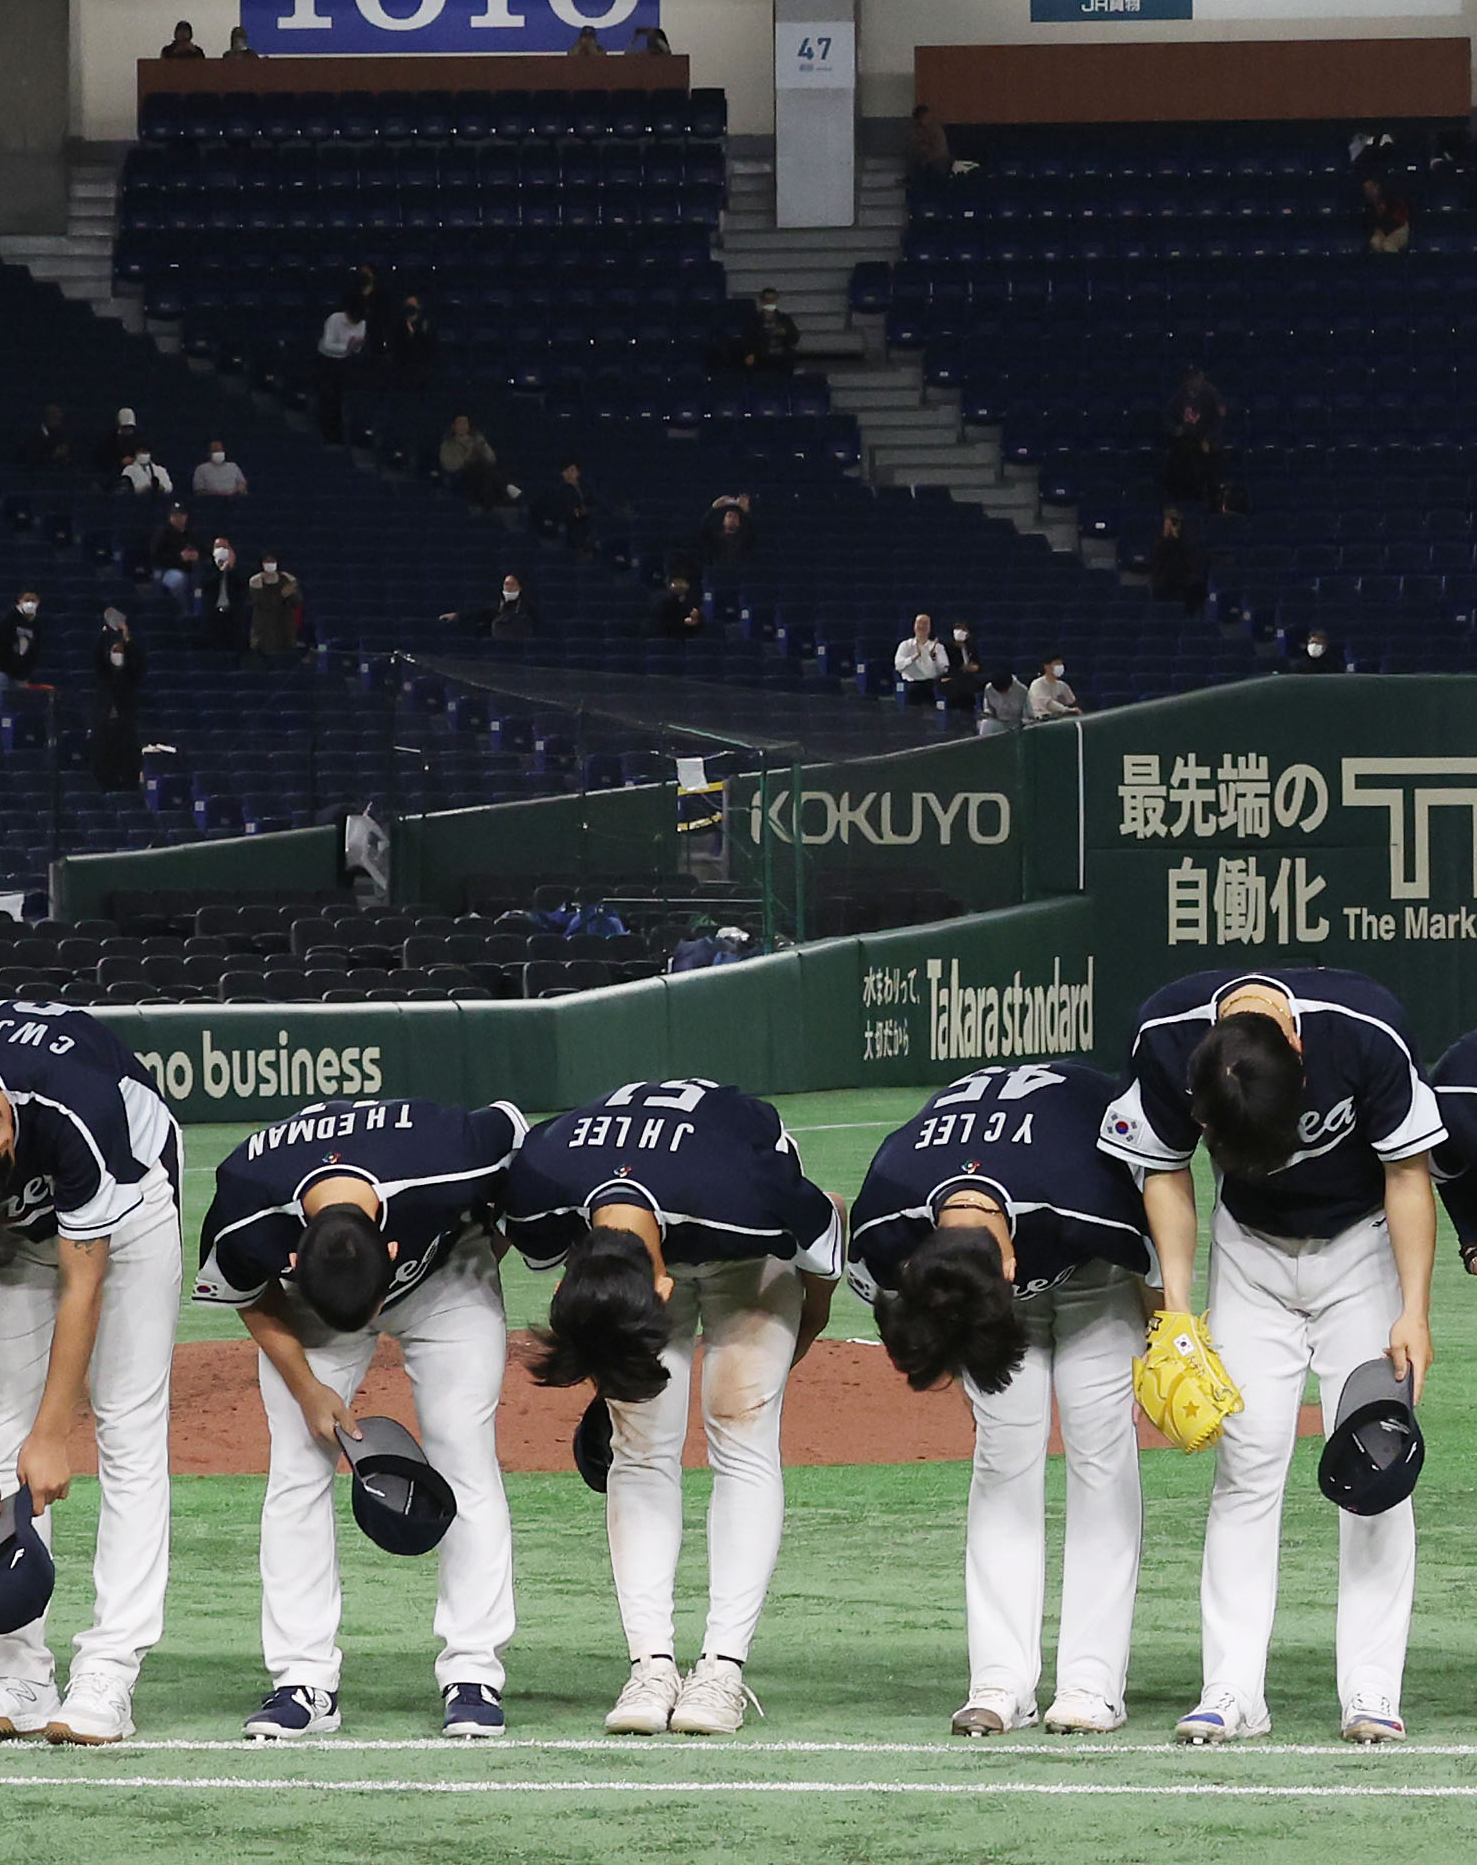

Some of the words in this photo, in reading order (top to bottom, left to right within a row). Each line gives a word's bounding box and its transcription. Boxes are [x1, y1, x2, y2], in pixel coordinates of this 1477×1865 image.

[797, 36, 834, 62] 47
[1118, 753, 1329, 840] 最先端の
[750, 791, 1011, 848] KOKUYO
[1343, 906, 1395, 944] The
[926, 957, 999, 1061] Takara
[1000, 955, 1095, 1057] standard
[6, 1023, 48, 1051] W
[49, 1034, 75, 1057] C
[202, 1029, 382, 1099] business
[603, 1079, 722, 1114] 51
[932, 1062, 1068, 1109] 45
[366, 1106, 388, 1131] H
[395, 1102, 414, 1130] T
[568, 1114, 633, 1149] LEE
[915, 1111, 977, 1150] LEE
[984, 1112, 1007, 1144] C
[1012, 1113, 1035, 1144] Y
[247, 1107, 355, 1161] EDMAN
[640, 1119, 663, 1149] H
[669, 1122, 695, 1153] J
